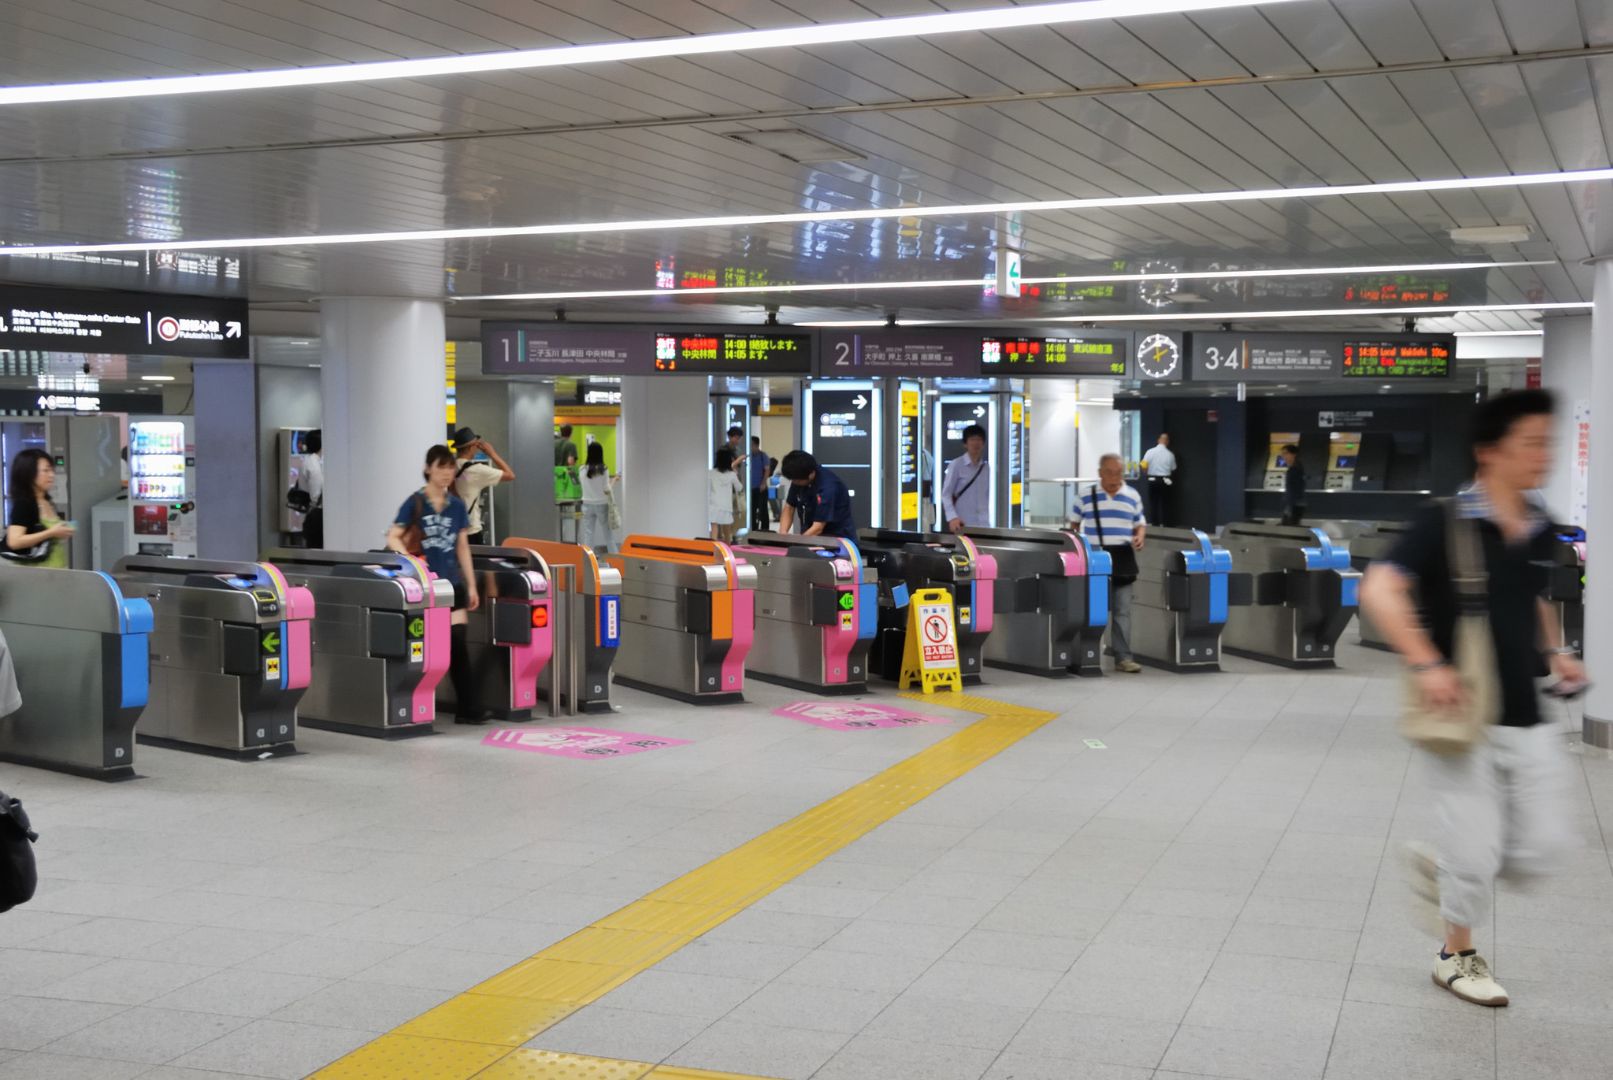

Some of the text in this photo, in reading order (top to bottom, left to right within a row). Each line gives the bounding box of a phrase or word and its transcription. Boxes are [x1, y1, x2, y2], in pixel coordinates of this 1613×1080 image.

[502, 338, 510, 363] 1
[835, 342, 850, 366] 2
[413, 622, 423, 633] IC
